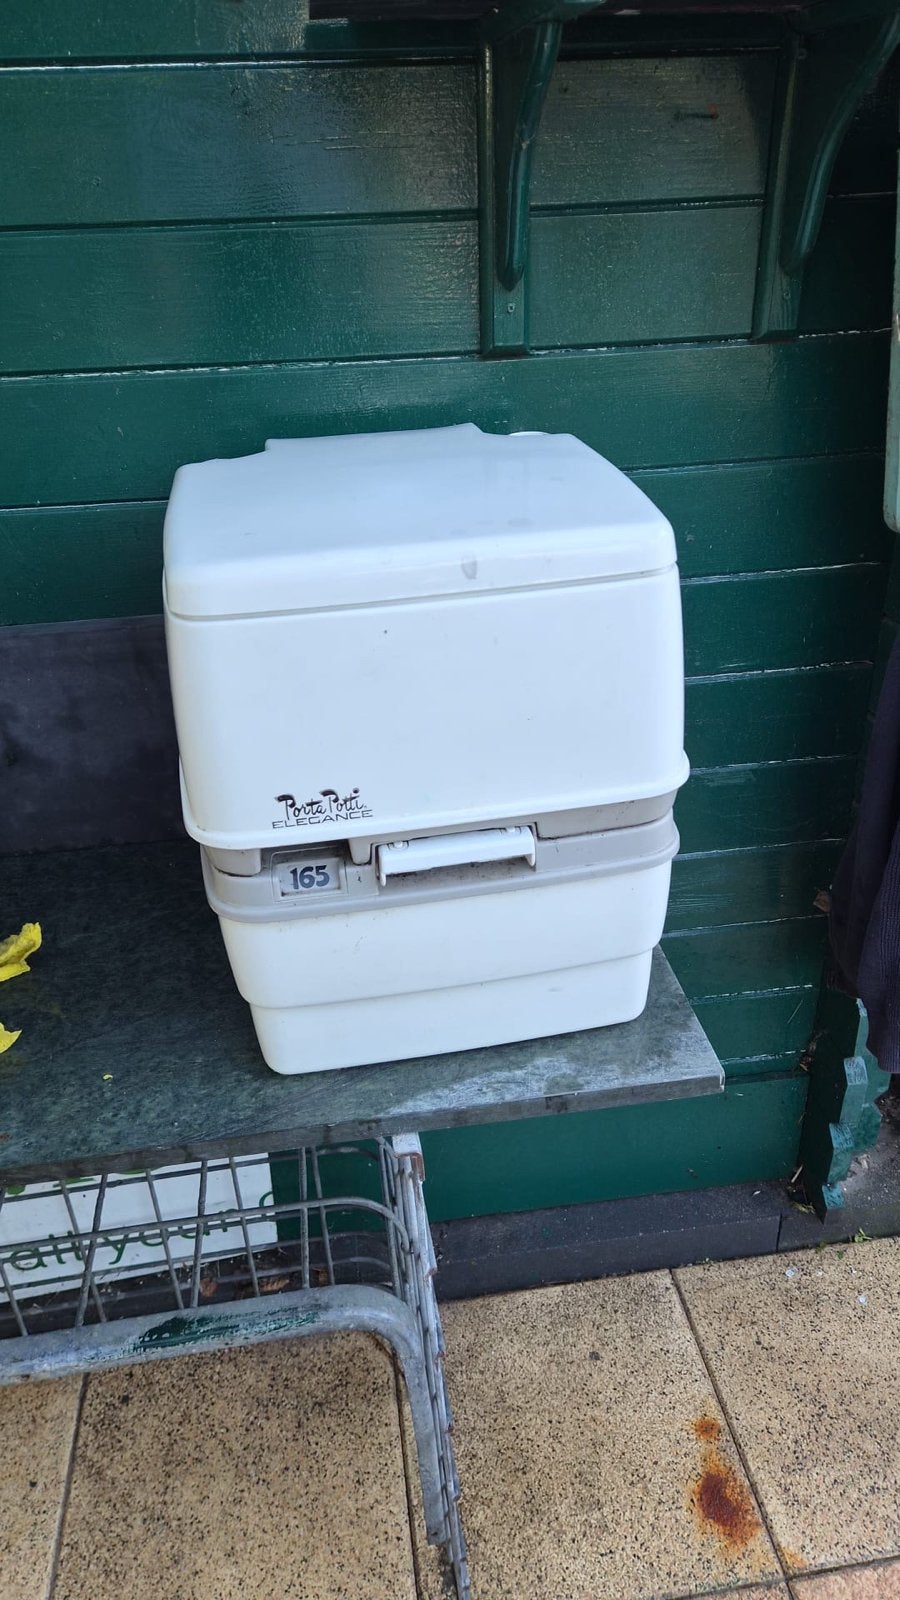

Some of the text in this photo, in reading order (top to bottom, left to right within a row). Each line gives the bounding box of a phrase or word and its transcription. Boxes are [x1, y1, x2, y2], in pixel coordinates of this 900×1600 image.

[275, 787, 364, 820] Porta Potti
[272, 809, 373, 828] ELEGANCE
[290, 864, 330, 890] 165
